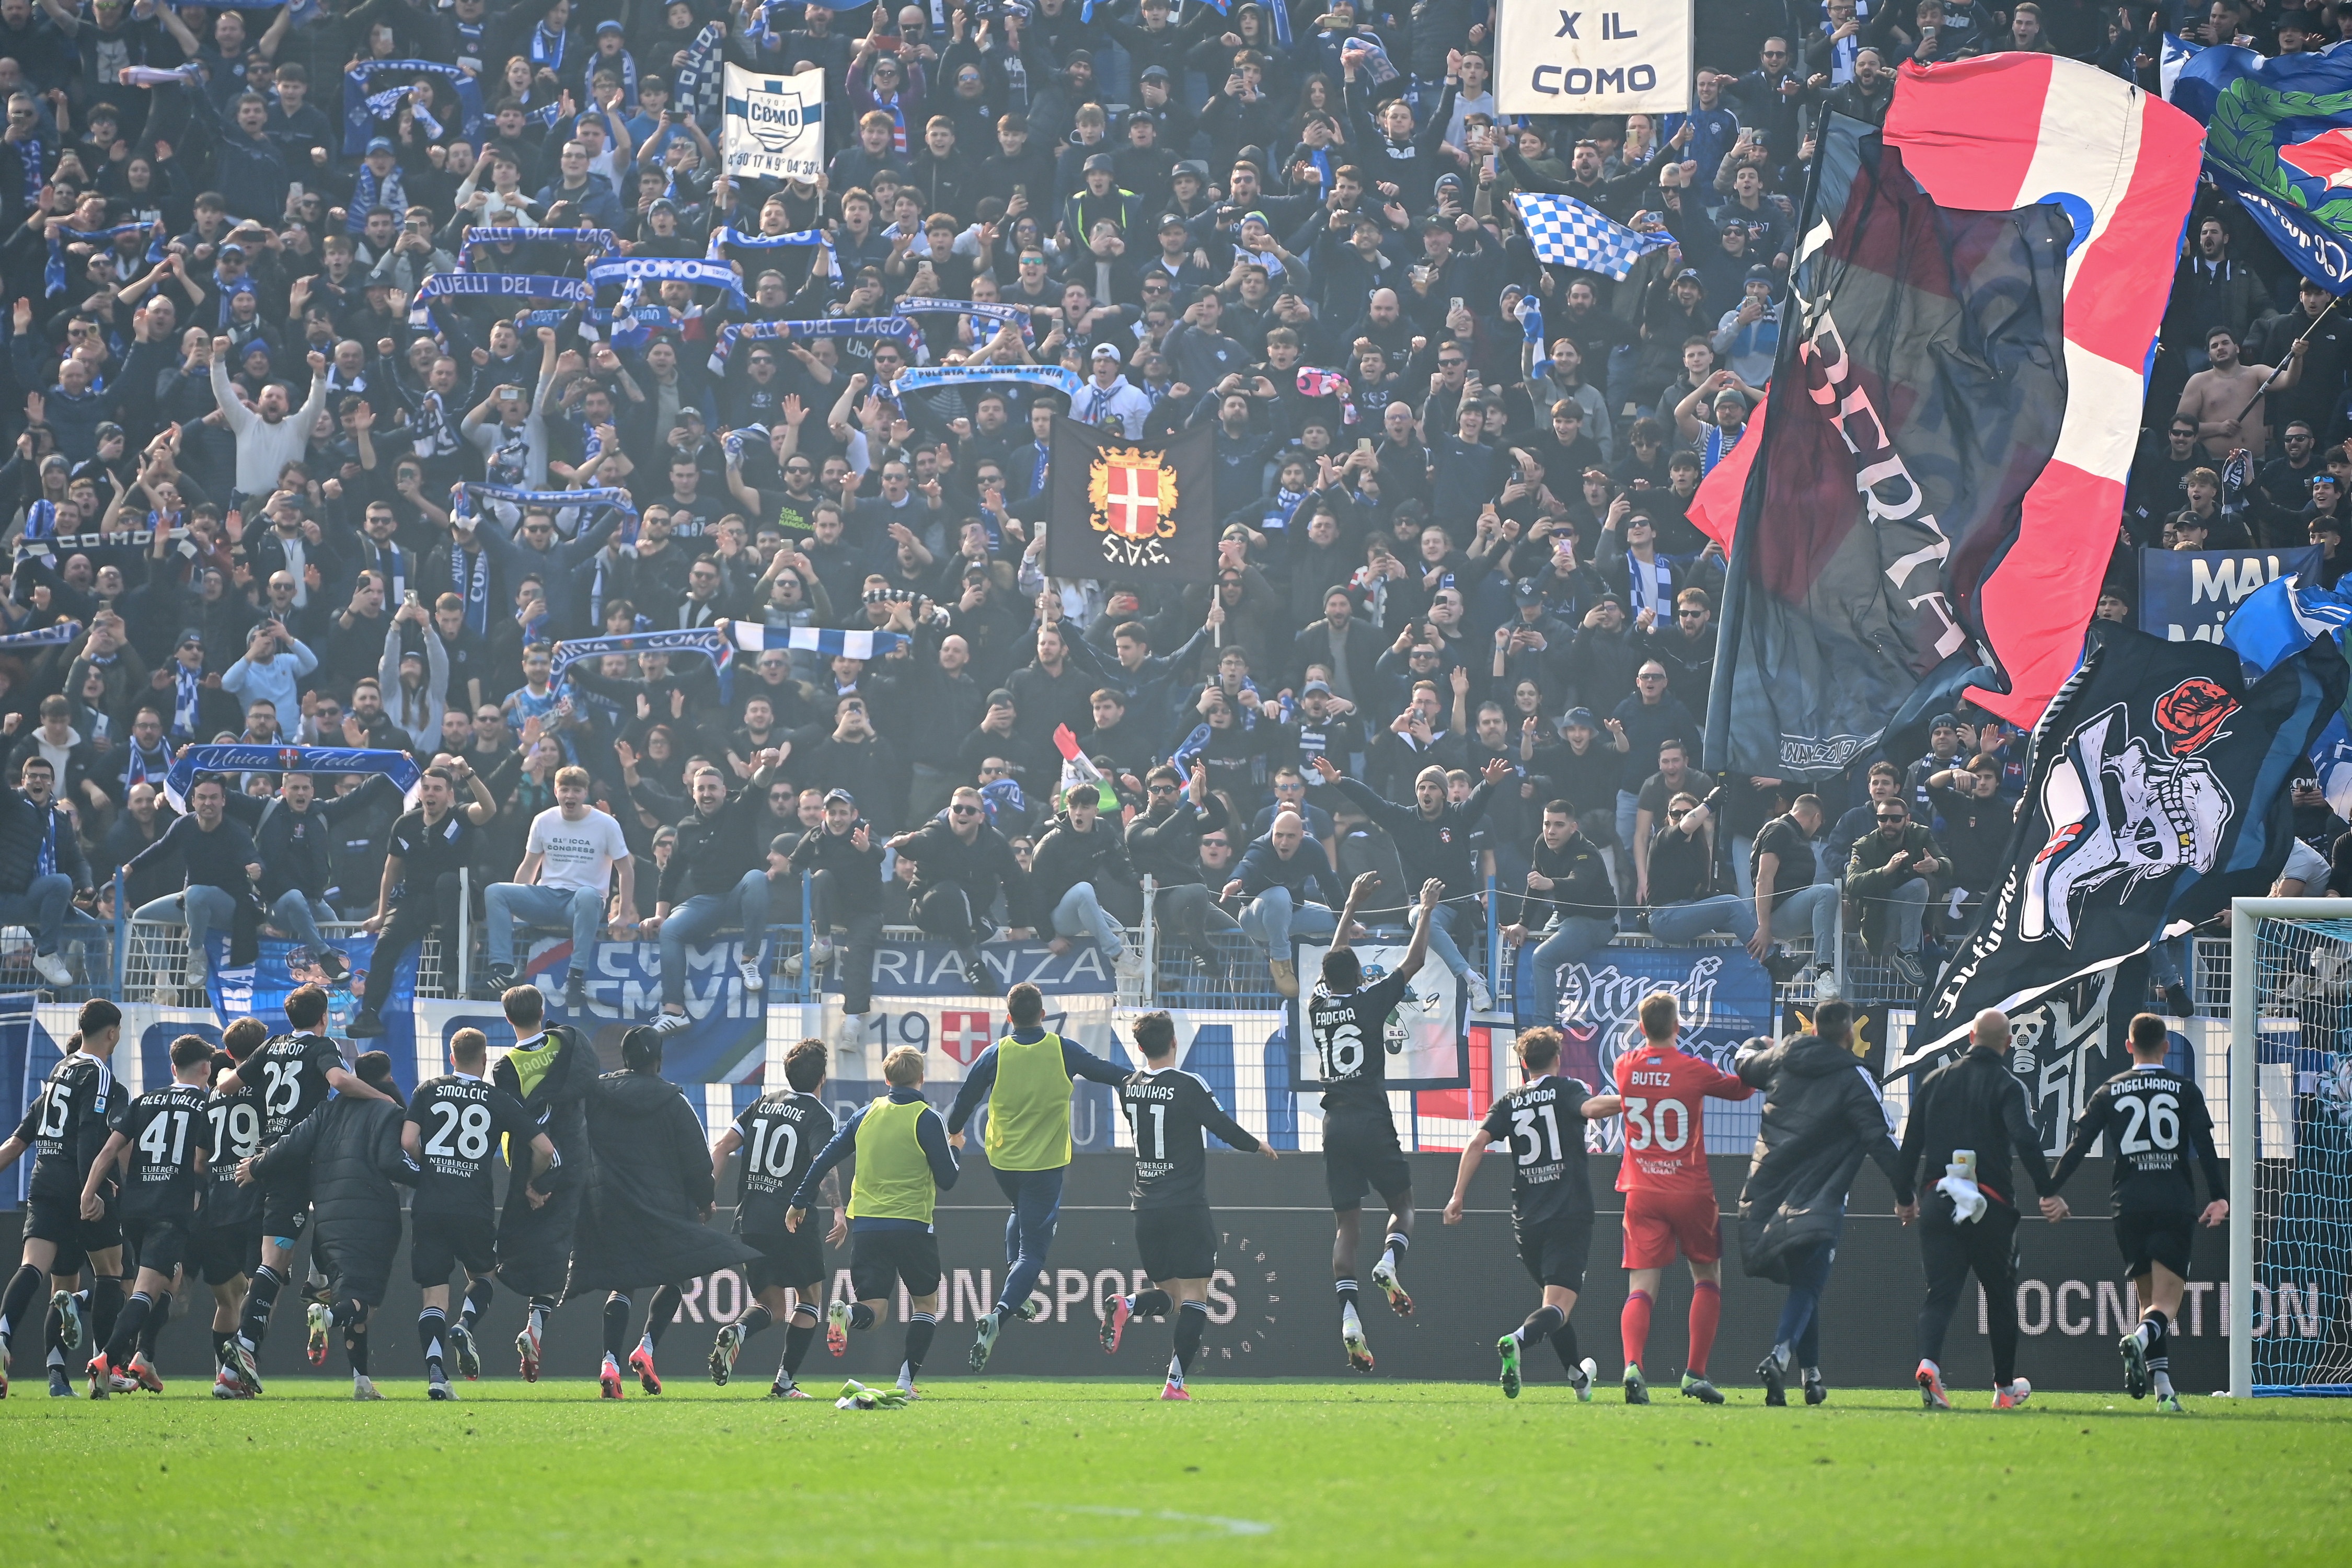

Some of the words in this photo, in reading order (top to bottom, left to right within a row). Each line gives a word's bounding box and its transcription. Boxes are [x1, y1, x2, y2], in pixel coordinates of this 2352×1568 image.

[1554, 9, 1582, 40] X
[1602, 12, 1638, 40] IL
[1532, 64, 1656, 95] COMO
[760, 97, 787, 107] 1907
[752, 102, 798, 126] COMO
[468, 227, 514, 243] UELLI
[625, 259, 704, 279] COMO
[429, 276, 489, 296] QUELLI
[501, 276, 534, 295] DEL
[551, 280, 587, 302] LAG
[803, 319, 837, 335] DEL
[854, 316, 907, 336] LAGO
[846, 336, 873, 360] Ube
[56, 530, 153, 548] COMO
[648, 632, 723, 652] COMO
[196, 747, 270, 767] Unica
[305, 750, 366, 767] Fede
[547, 845, 595, 854] CONGRESS
[1315, 1007, 1356, 1026] FADERA
[267, 1042, 308, 1056] PERRON
[1313, 1023, 1364, 1079] 16
[263, 1060, 303, 1116] 23
[1631, 1071, 1671, 1087] BUTEZ
[2111, 1077, 2182, 1096] ENGELHARDT
[1125, 1084, 1175, 1100] DOUVIKAS
[38, 1081, 72, 1138] 15
[140, 1093, 168, 1106] ALEX
[171, 1093, 206, 1112] VALLE
[758, 1101, 806, 1122] CUTRONE
[207, 1103, 260, 1163] 79
[424, 1101, 491, 1160] 28
[1126, 1103, 1165, 1159] 11
[1624, 1097, 1689, 1152] 30
[2114, 1092, 2180, 1156] 26
[139, 1110, 190, 1165] 41
[1511, 1104, 1563, 1166] 31
[749, 1118, 798, 1178] 10
[142, 1165, 179, 1175] EUBERGER
[429, 1157, 480, 1171] NEUBERGER
[436, 1166, 471, 1178] BERMAN
[2138, 1162, 2172, 1171] BERMAN
[142, 1173, 171, 1182] BERMAN
